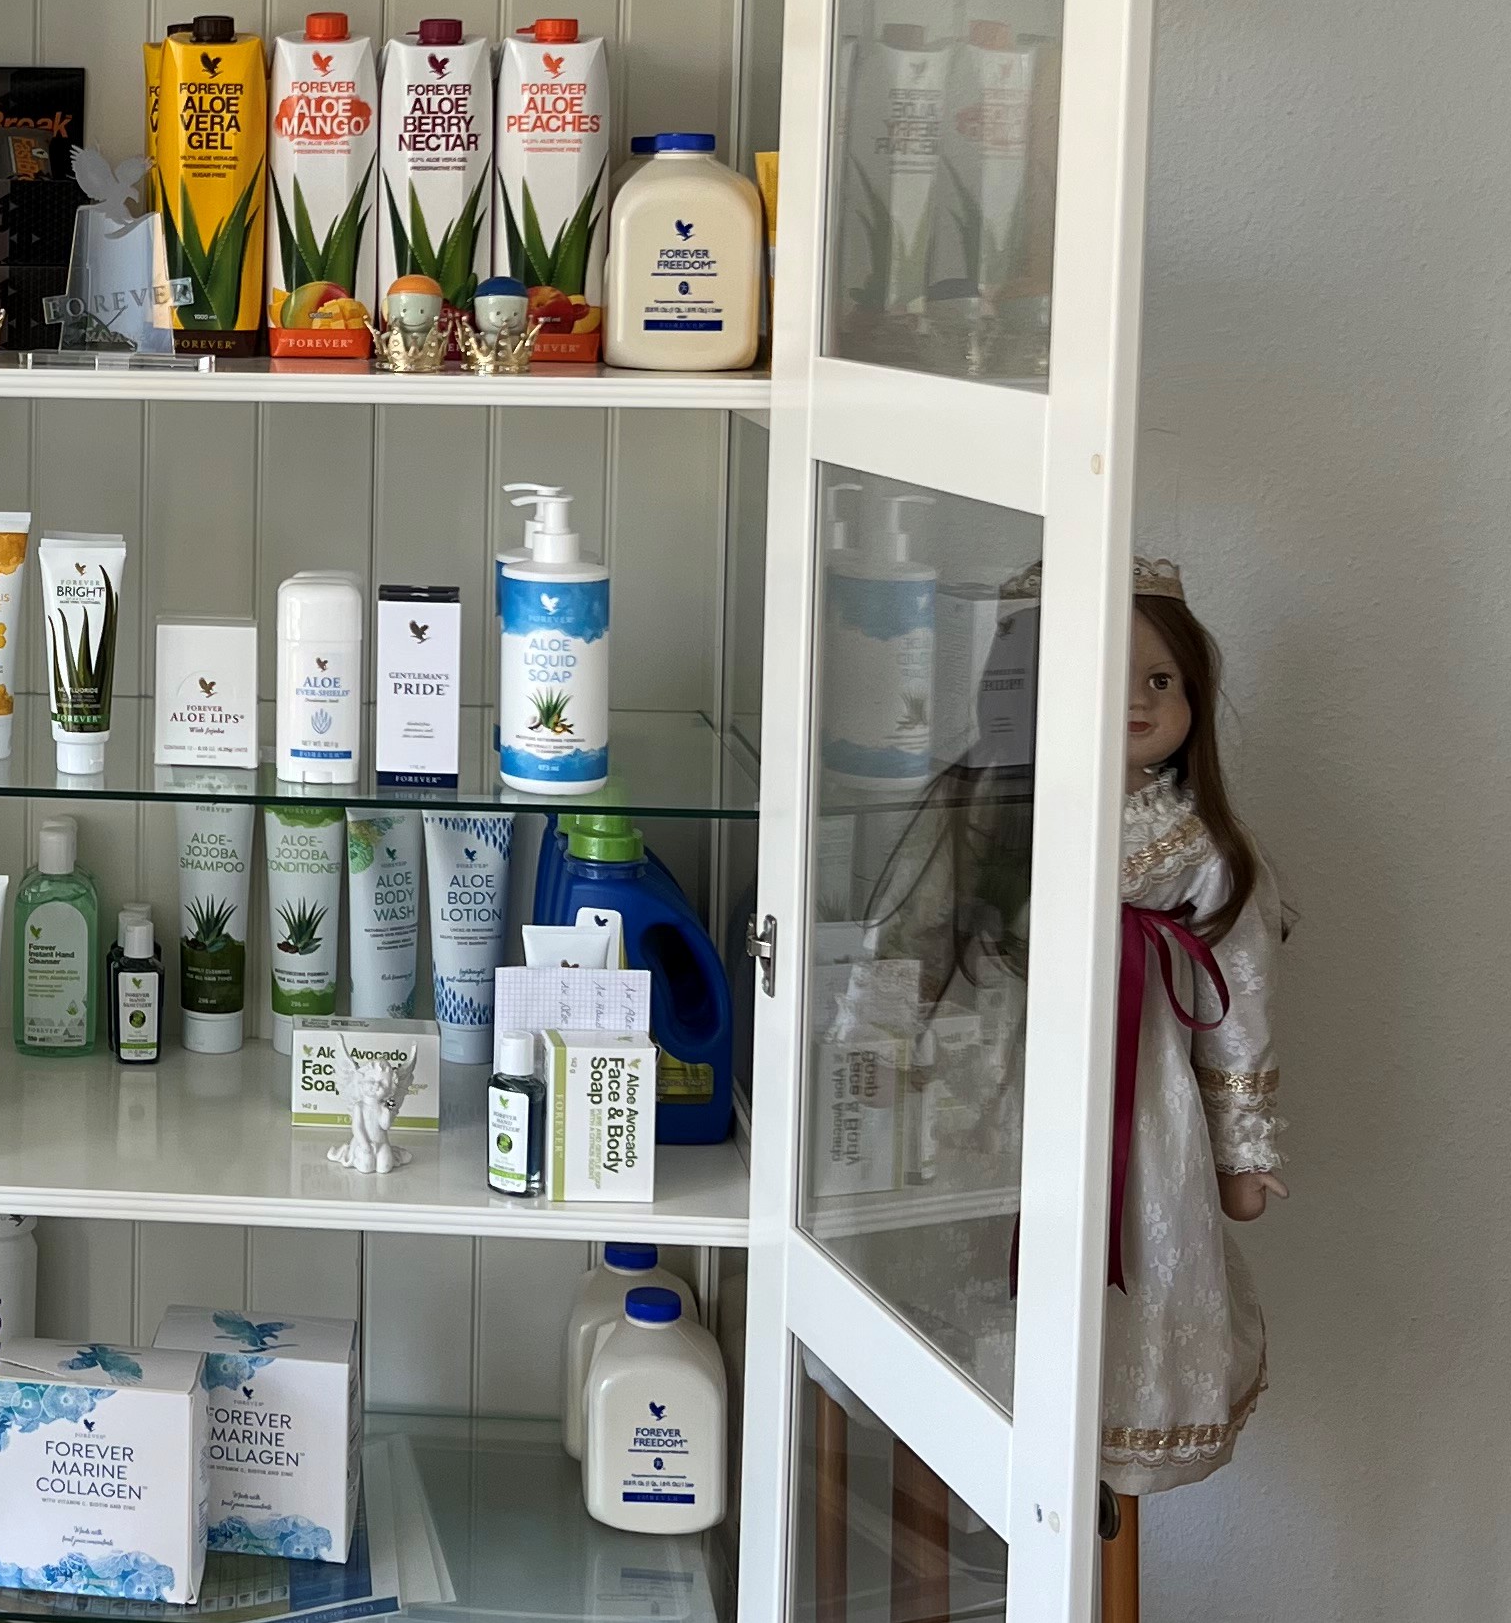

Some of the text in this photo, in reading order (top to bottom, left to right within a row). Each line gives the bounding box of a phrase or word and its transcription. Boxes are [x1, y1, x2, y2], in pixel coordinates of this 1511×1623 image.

[180, 82, 243, 95] FOREVER
[291, 81, 355, 93] FOREVER
[407, 84, 472, 96] FOREVER
[521, 83, 587, 96] FOREVER
[183, 96, 240, 114] ALOE
[293, 98, 351, 117] ALOE
[411, 97, 468, 115] ALOE
[524, 97, 583, 115] ALOE
[180, 114, 241, 133] VERA
[281, 116, 365, 136] MANGO
[403, 115, 474, 133] BERRY
[507, 115, 600, 133] PEACHES
[188, 132, 233, 151] GEL
[398, 133, 479, 152] NECTAR
[659, 249, 709, 259] FOREVER
[657, 260, 711, 270] FREEDOM
[47, 280, 194, 320] FOREVER
[174, 339, 233, 349] FOREVER
[288, 339, 348, 348] FOREVER
[56, 586, 104, 598] BRIGHT
[529, 639, 572, 652] ALOE
[524, 654, 577, 669] LIQUID
[303, 676, 341, 688] ALOE
[388, 672, 450, 680] GENTLEMAN'S
[528, 670, 573, 683] SOAP
[295, 688, 350, 697] EVER-SHIELD
[393, 682, 446, 696] PRIDE
[56, 714, 99, 723] FOREVER
[169, 712, 240, 724] ALOE LIPS
[395, 775, 438, 784] FOREVER
[190, 832, 233, 845] ALOE-
[280, 835, 323, 847] ALOE-
[185, 845, 239, 859] JOJOBA
[275, 848, 329, 861] JOJOBA
[179, 859, 245, 873] SHAMPOO
[376, 872, 413, 888] ALOE
[449, 874, 495, 888] ALOE
[374, 888, 415, 905] BODY
[448, 891, 497, 905] BODY
[373, 905, 415, 922] WASH
[440, 908, 502, 922] LOTION
[28, 943, 57, 951] Forever
[350, 1047, 408, 1062] Avocado
[587, 1056, 607, 1105] Soap
[603, 1057, 625, 1174] Face & Body
[625, 1073, 640, 1168] Aloe Avocado
[554, 1094, 563, 1152] FOREVER
[210, 1426, 285, 1448] MARINE
[635, 1428, 682, 1438] FOREVER
[633, 1437, 685, 1448] FREEDOM
[45, 1440, 134, 1462] FOREVER
[210, 1444, 299, 1467] OLLAGEN
[51, 1460, 128, 1480] MARINE
[36, 1476, 142, 1500] COLLAGEN
